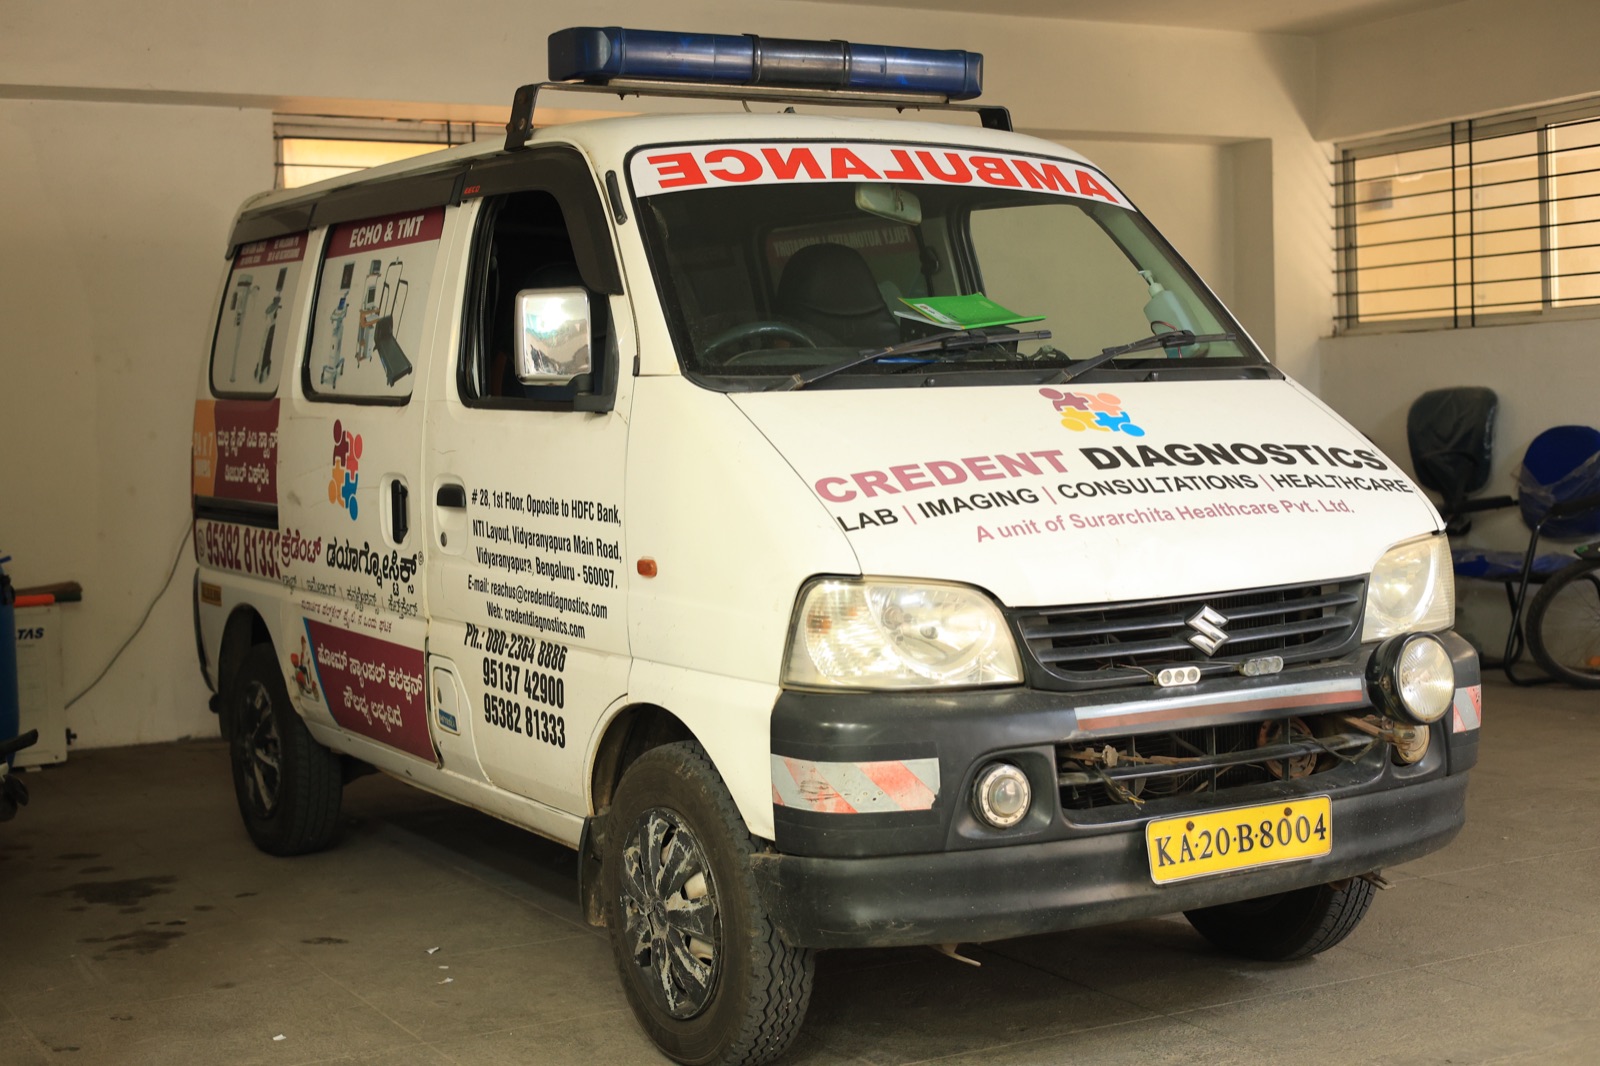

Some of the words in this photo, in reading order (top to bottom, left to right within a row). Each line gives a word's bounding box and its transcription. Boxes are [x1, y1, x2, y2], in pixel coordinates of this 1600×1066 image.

[349, 223, 382, 248] ECHO
[384, 221, 394, 242] &
[397, 215, 424, 239] TMT
[814, 449, 1069, 503] CREDENT
[1078, 443, 1388, 471] DIAGNOSTICS
[480, 489, 491, 510] 28,
[492, 491, 503, 509] 1st
[505, 492, 525, 514] Floor,
[526, 494, 559, 518] Opposite
[561, 499, 569, 518] to
[571, 499, 595, 521] HDFC
[597, 502, 622, 527] Bank,
[836, 508, 899, 532] LAB
[917, 488, 1040, 518] IMAGING
[1057, 474, 1259, 499] CONSULTATIONS
[1271, 474, 1413, 493] HEALTHCARE
[976, 525, 995, 543] A
[997, 517, 1041, 538] unit
[1044, 514, 1066, 532] of
[1068, 506, 1175, 529] Surarchita
[1175, 501, 1280, 521] Healthcare
[1280, 499, 1318, 514] Pvt.
[1319, 499, 1355, 514] Ltd.
[206, 521, 241, 570] 95382
[472, 519, 485, 537] NTI
[486, 521, 511, 545] Layout,
[512, 526, 571, 554] Vidyaranyapura
[573, 535, 594, 557] Main
[596, 538, 622, 564] Road,
[536, 557, 575, 582] Bengaluru
[582, 565, 618, 589] 560097.
[468, 574, 490, 594] E-mail:
[490, 581, 608, 620] reachus@credentdiagnostics.com
[15, 627, 44, 640] TAS
[486, 601, 503, 619] Web:
[504, 608, 586, 639] credentdiagnostics.com
[485, 627, 536, 664] 080-2364
[537, 640, 568, 673] 8886
[483, 657, 520, 695] 95137
[524, 669, 565, 709] 42900
[484, 692, 522, 734] 95382
[525, 706, 565, 749] 81333
